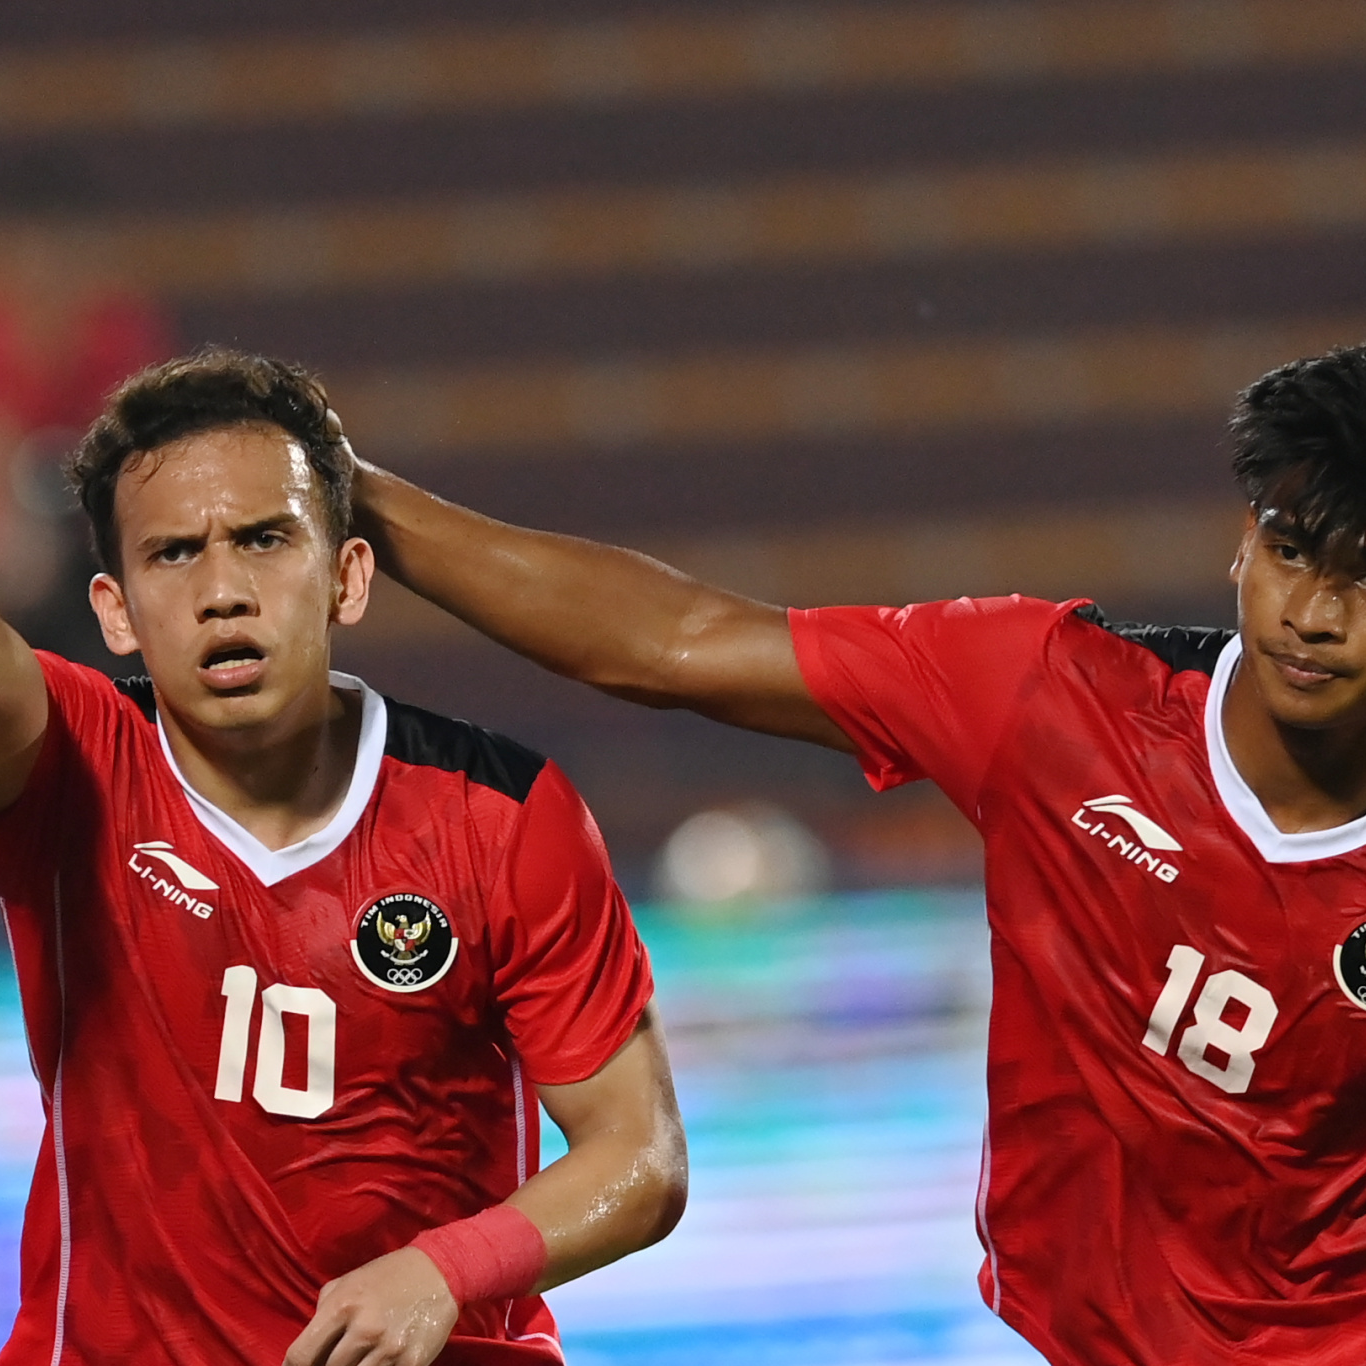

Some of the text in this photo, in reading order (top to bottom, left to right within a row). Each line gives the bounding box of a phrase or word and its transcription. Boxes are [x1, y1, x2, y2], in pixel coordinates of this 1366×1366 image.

[1071, 808, 1180, 884] LI-NING
[128, 853, 214, 920] LI-NING
[360, 893, 449, 929] TIM INDONESIA
[214, 964, 336, 1119] 10
[1141, 944, 1279, 1094] 18
